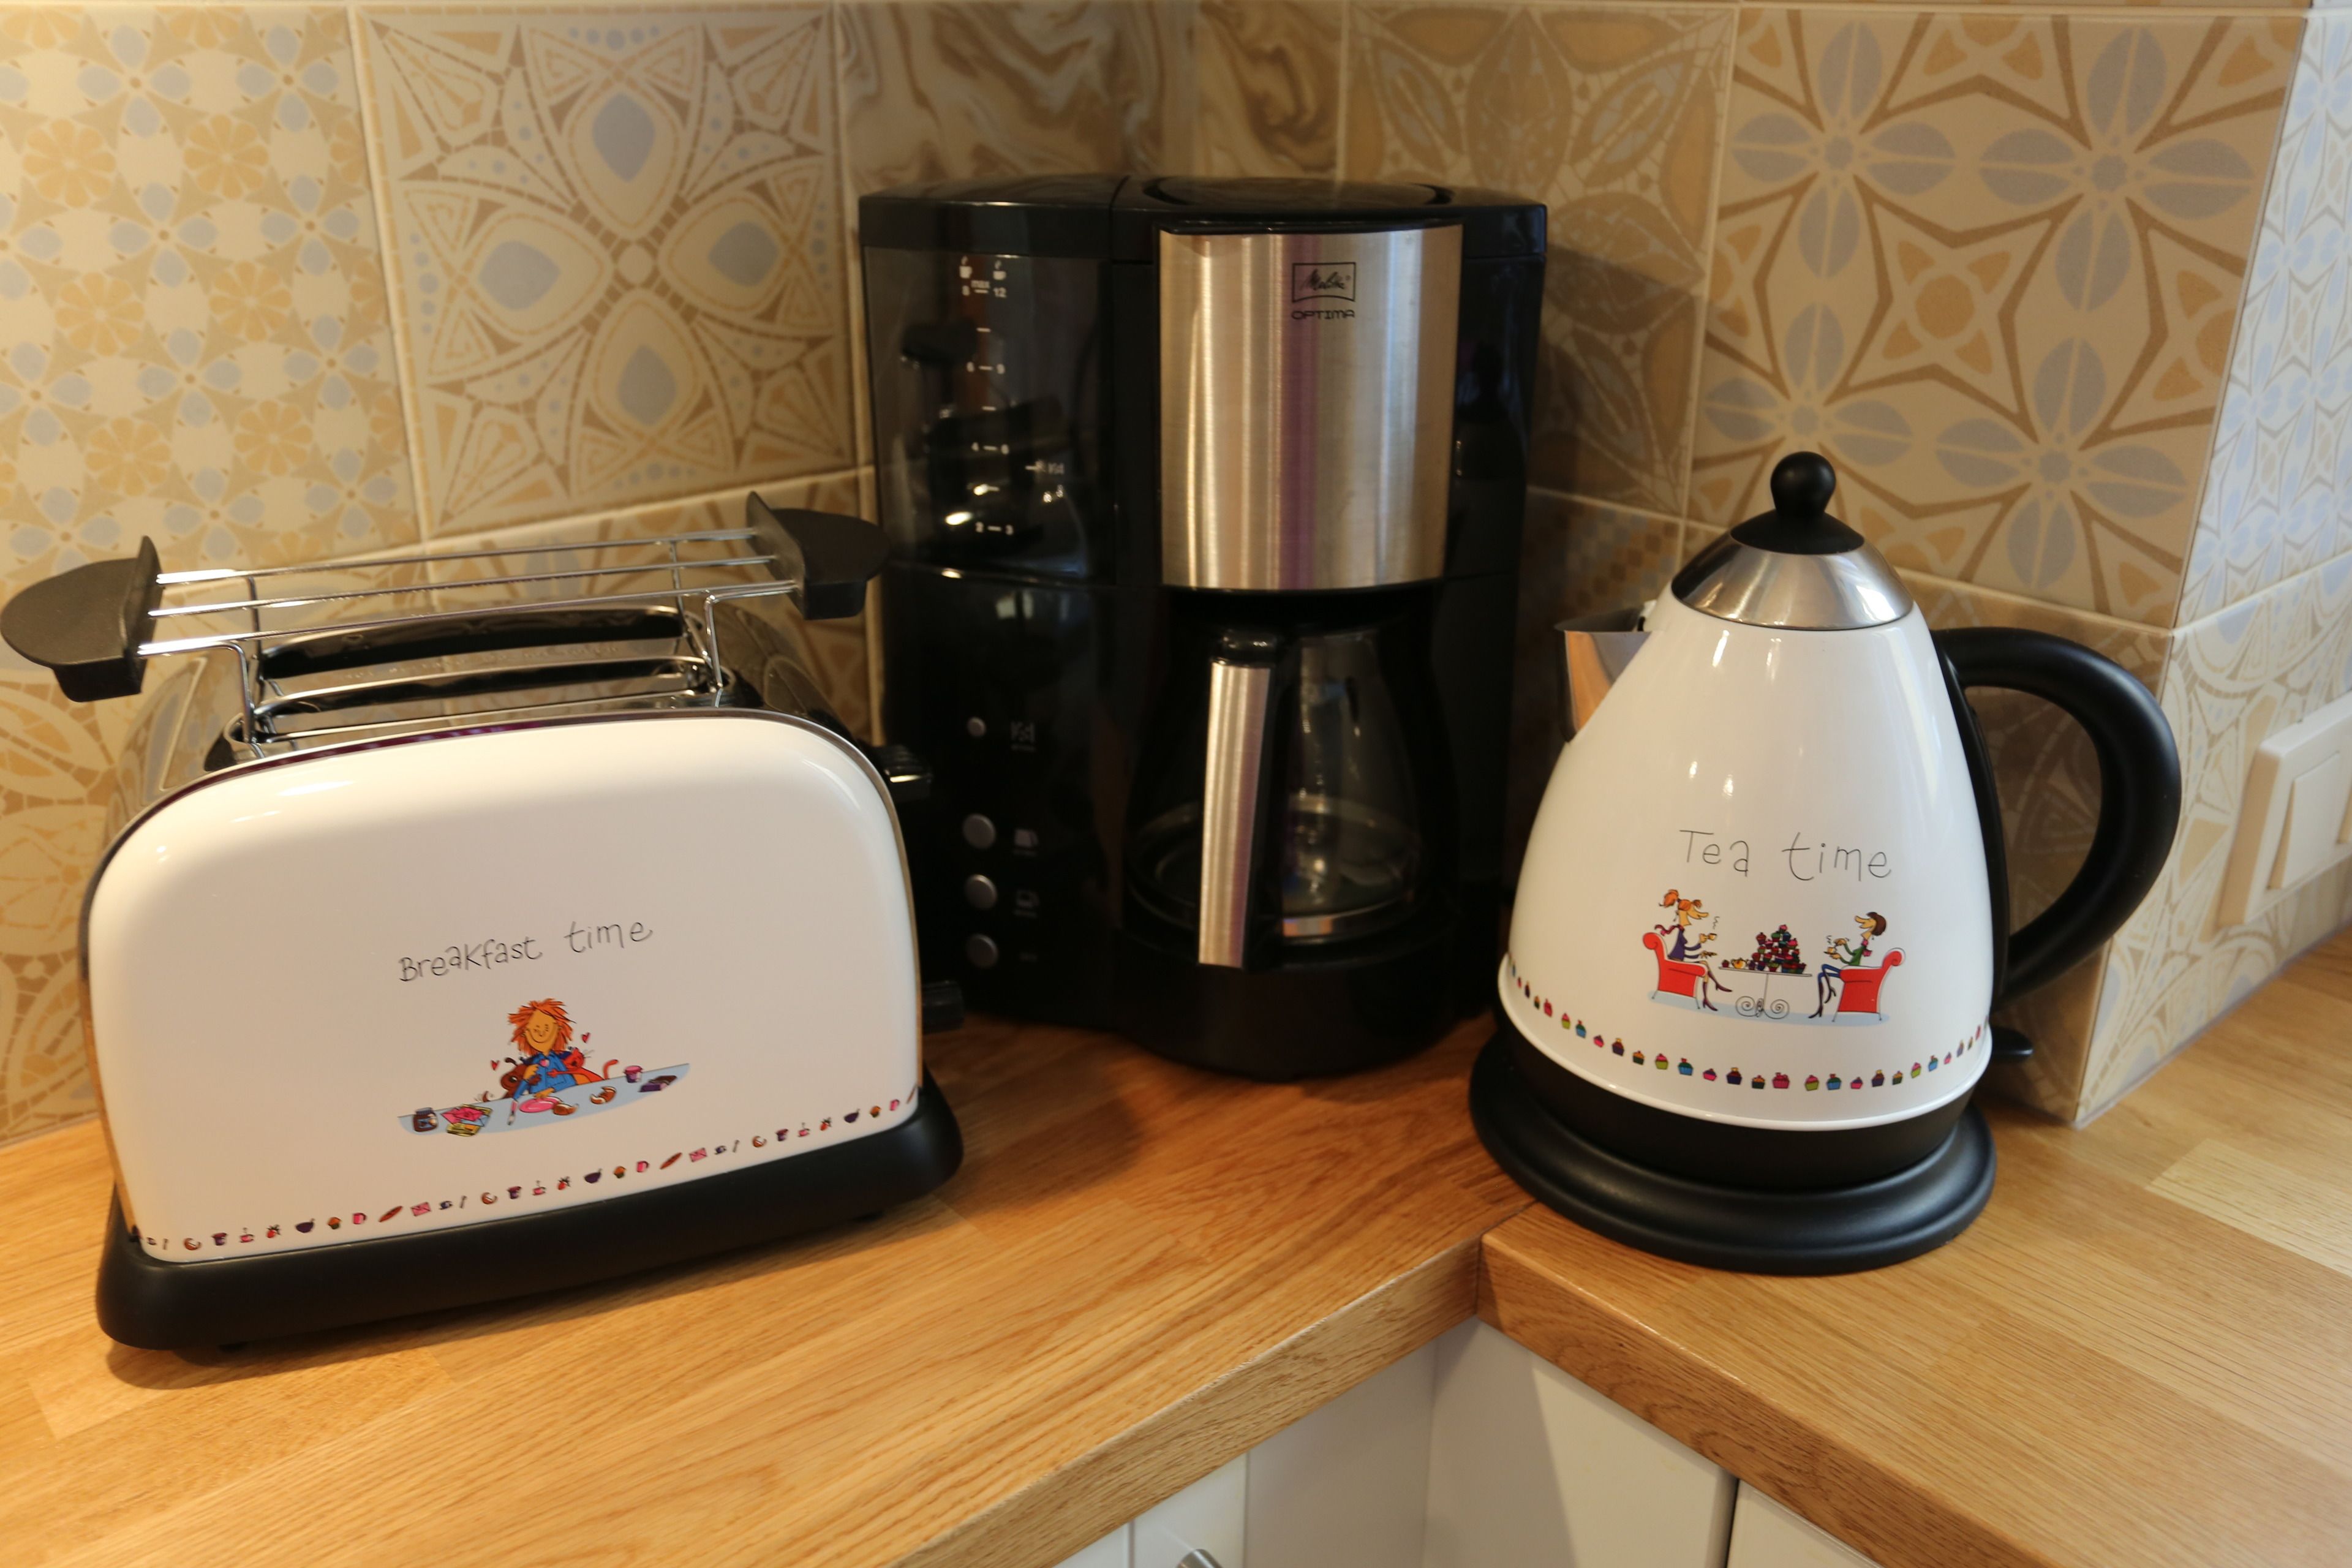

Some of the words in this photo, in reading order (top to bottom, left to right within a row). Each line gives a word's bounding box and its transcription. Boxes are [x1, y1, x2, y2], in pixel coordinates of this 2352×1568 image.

[993, 287, 1008, 298] 12
[1291, 309, 1355, 320] OPTIMA
[1679, 830, 1749, 877] Tea
[1781, 832, 1891, 882] time
[398, 936, 543, 982] Breakfast
[564, 921, 653, 952] time
